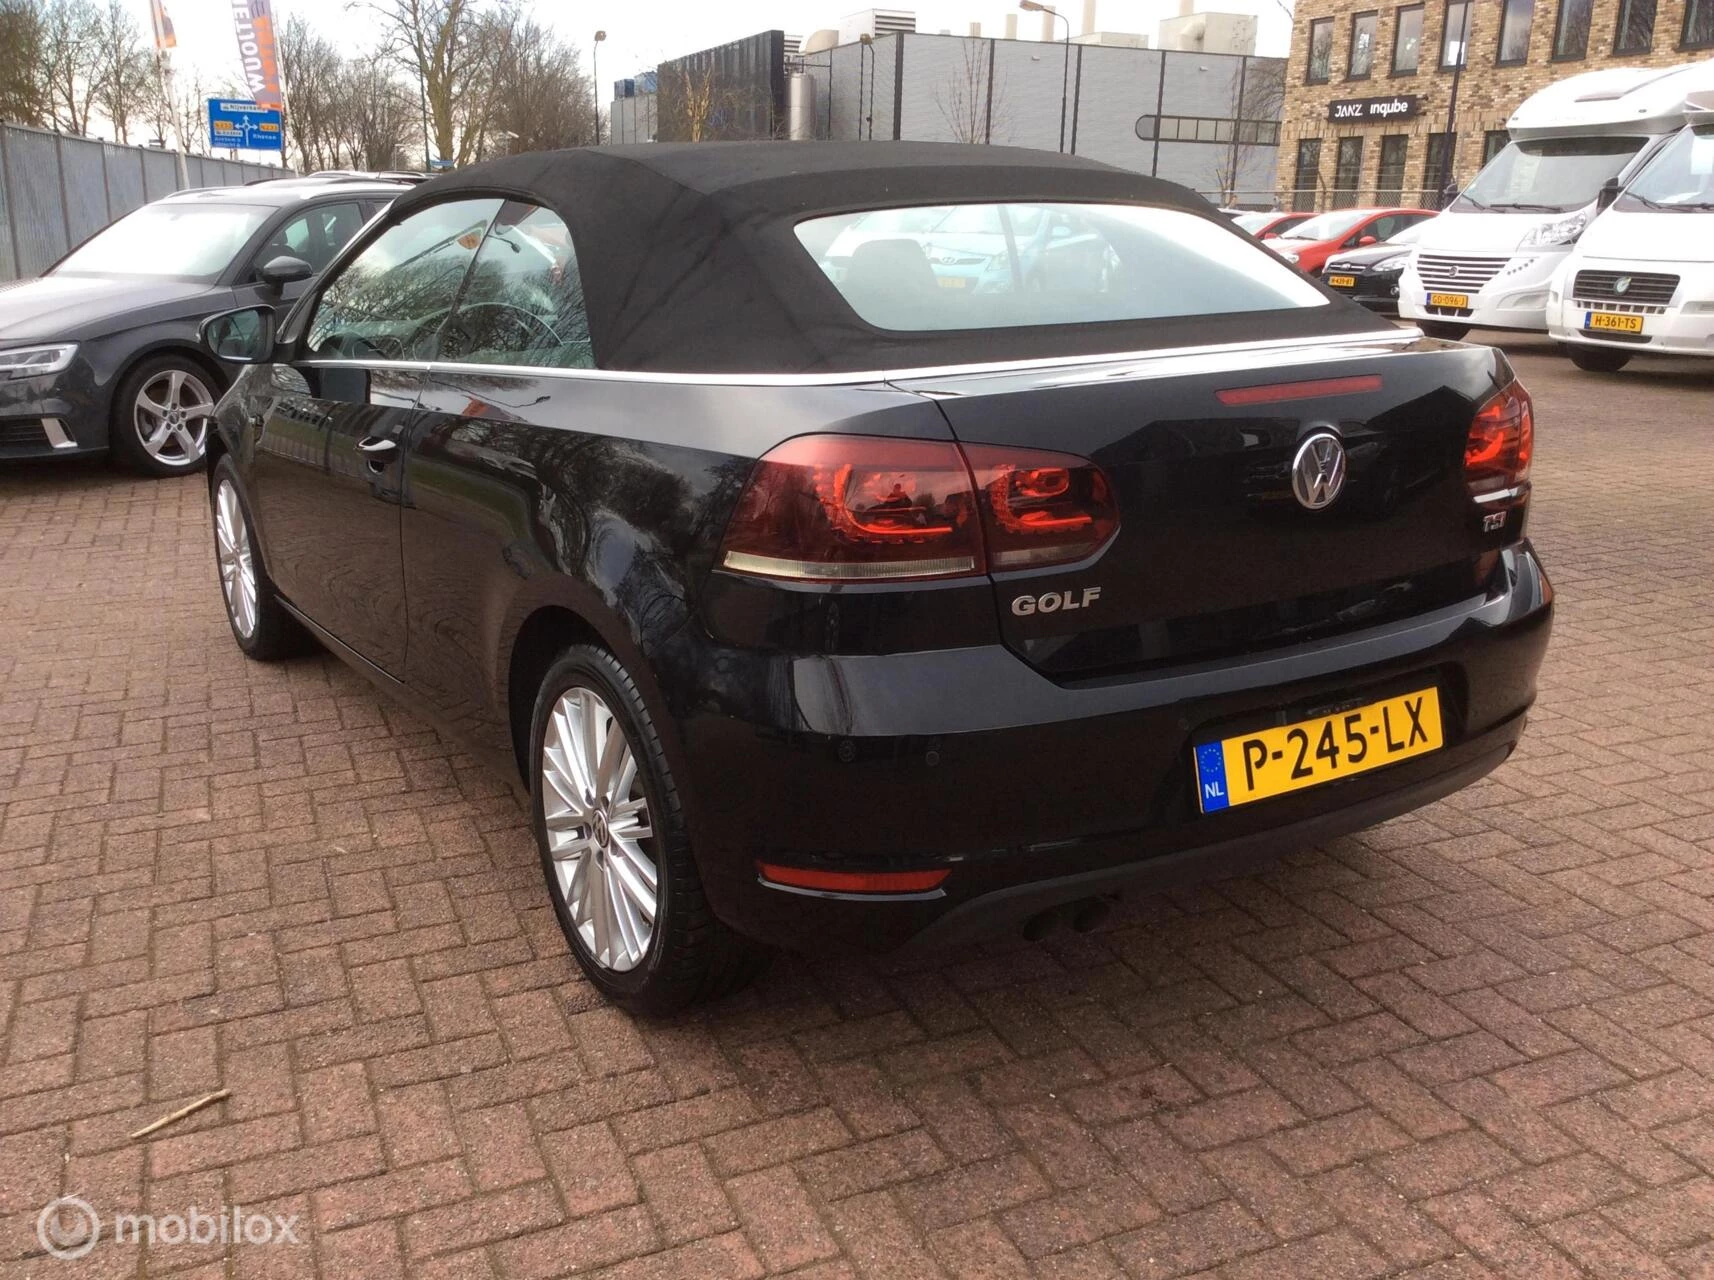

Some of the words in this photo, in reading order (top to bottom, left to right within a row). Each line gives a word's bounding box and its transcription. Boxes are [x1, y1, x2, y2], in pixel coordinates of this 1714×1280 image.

[1334, 104, 1363, 118] JANZ
[1594, 315, 1637, 329] H-361-TS
[1483, 511, 1507, 533] TSI
[1011, 586, 1101, 616] GOLF
[1205, 781, 1225, 799] NL
[1243, 697, 1428, 791] P-245-LX
